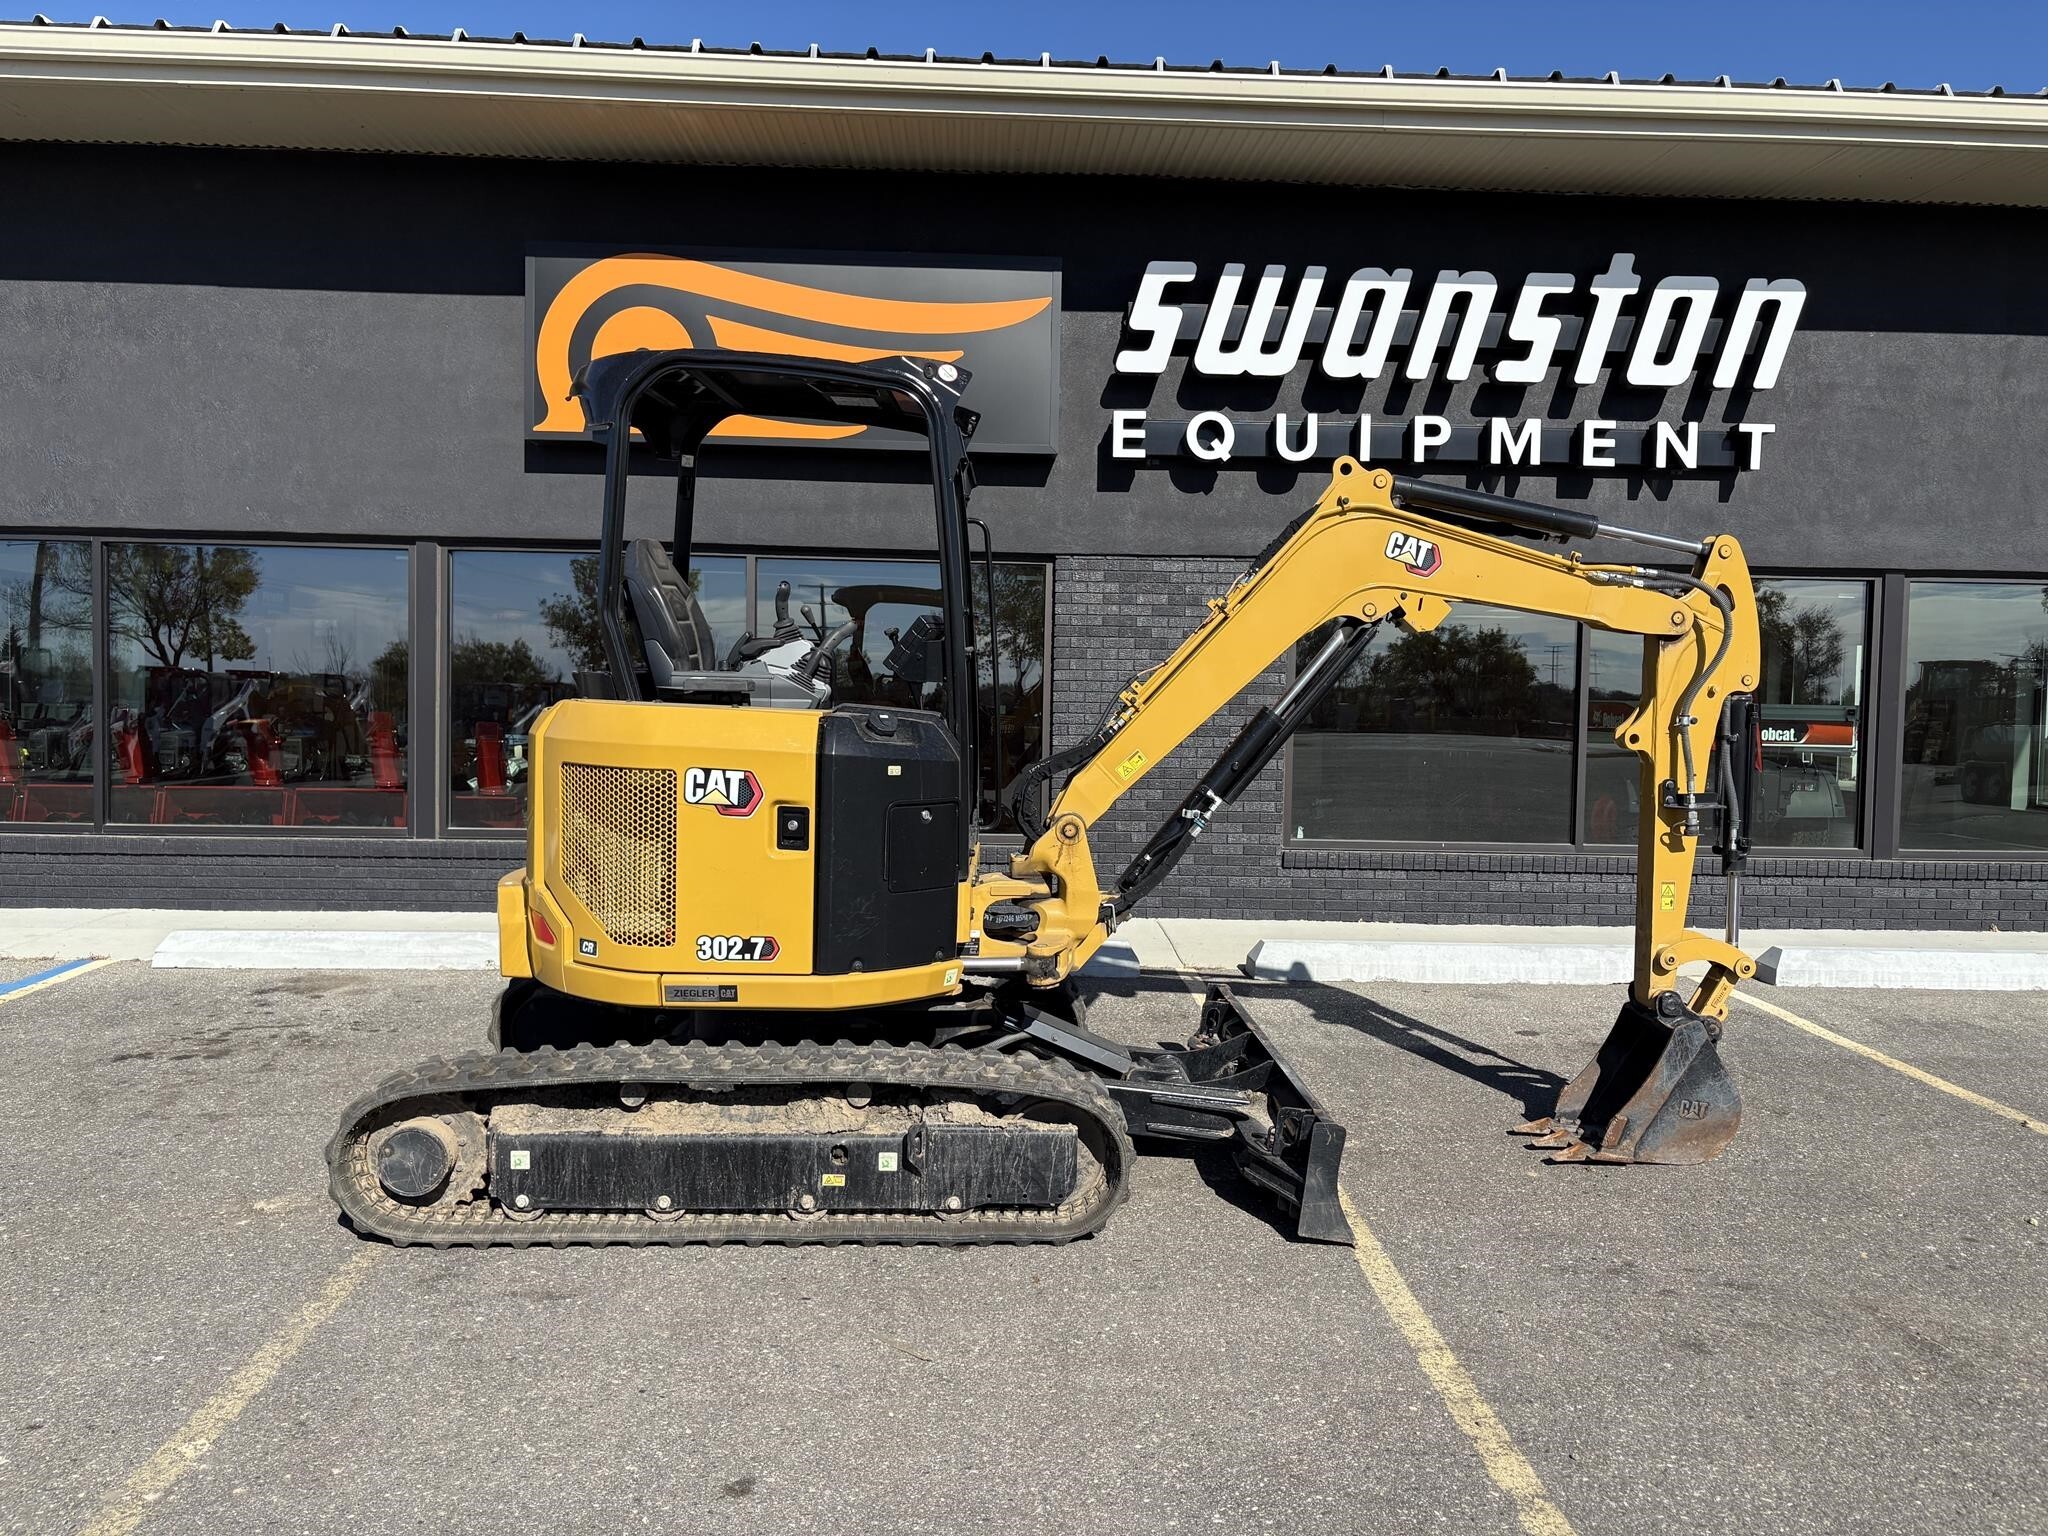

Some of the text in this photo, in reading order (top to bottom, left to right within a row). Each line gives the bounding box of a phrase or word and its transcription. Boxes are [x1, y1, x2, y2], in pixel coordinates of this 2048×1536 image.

[1111, 410, 1777, 471] EQUIPMENT
[1385, 531, 1433, 568] CAT
[1760, 727, 1797, 741] obcat
[684, 767, 745, 806] CAT
[582, 941, 595, 954] CR
[696, 935, 766, 961] 302.7
[673, 989, 736, 998] ZIEGLER CAT
[1680, 1099, 1709, 1120] CAT
